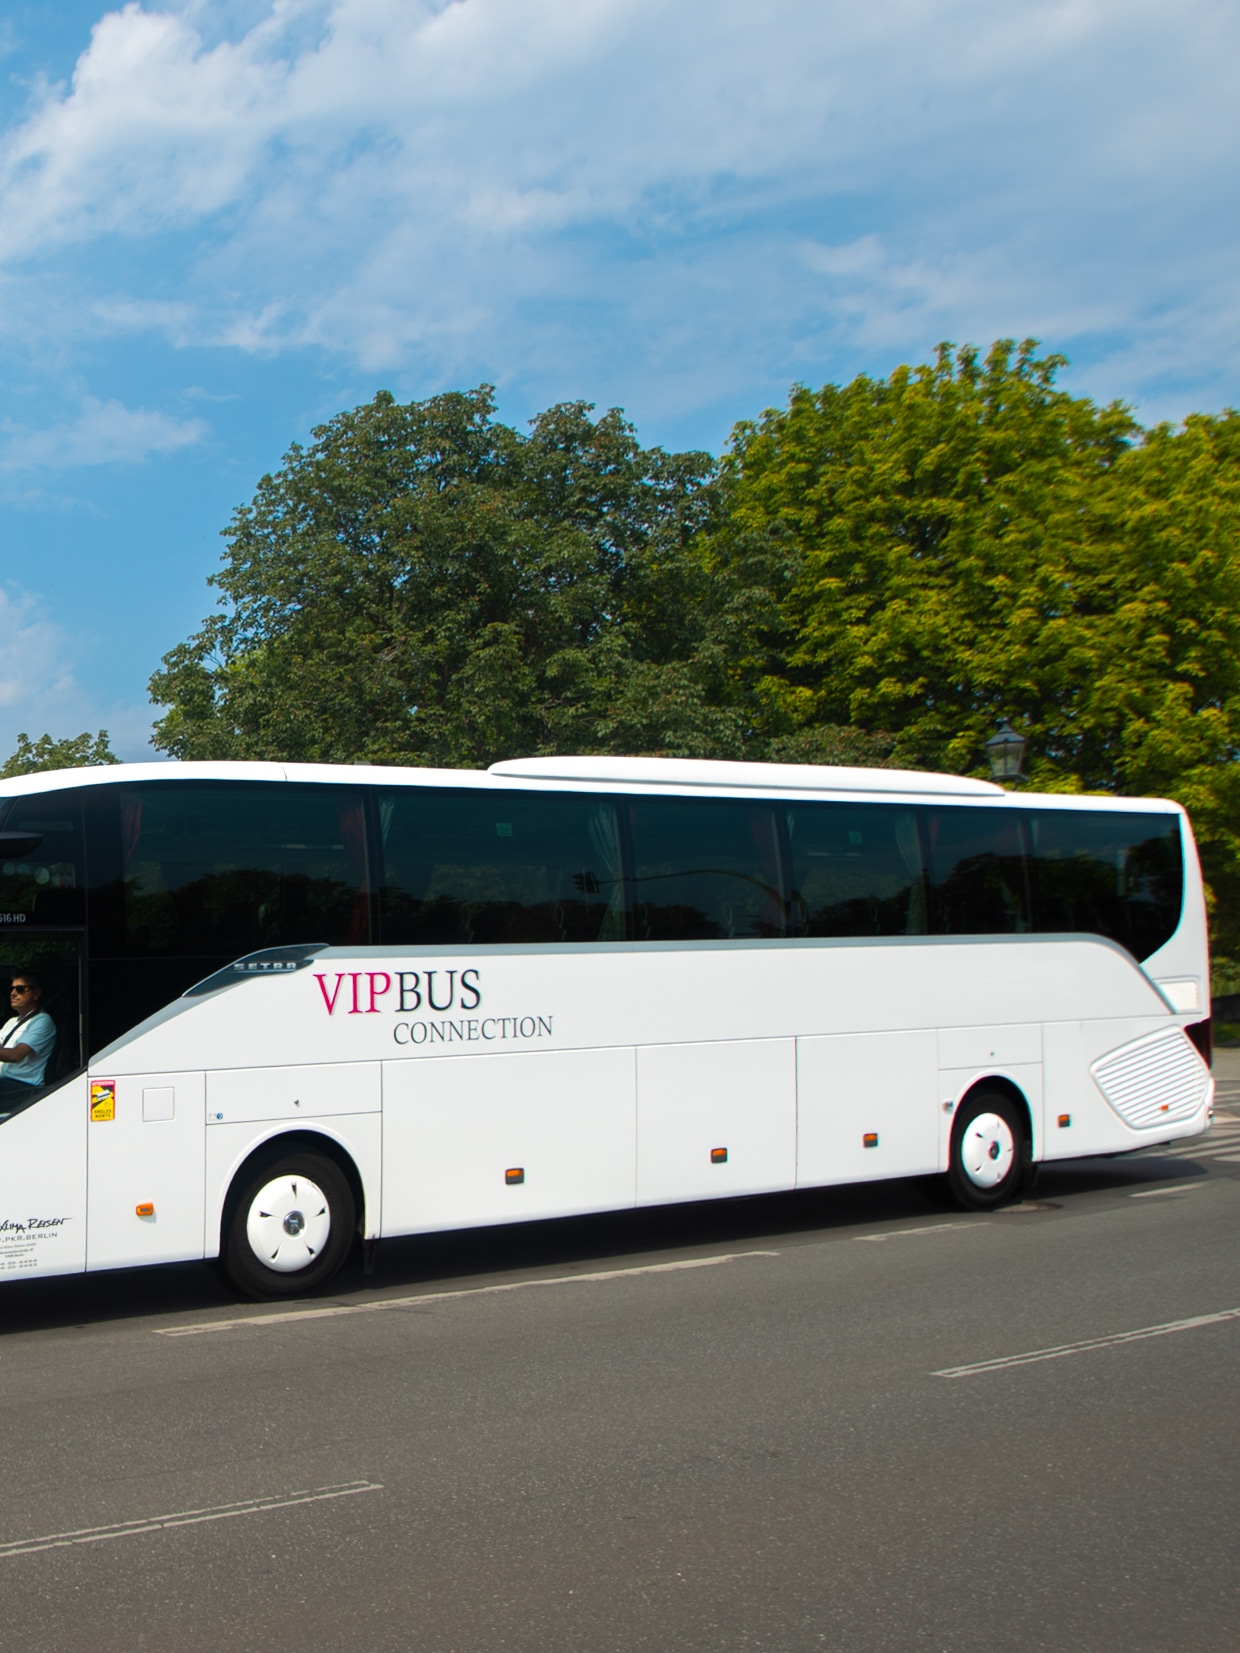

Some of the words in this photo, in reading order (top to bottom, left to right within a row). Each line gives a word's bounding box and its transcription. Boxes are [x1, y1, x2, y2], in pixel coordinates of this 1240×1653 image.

[12, 913, 26, 923] HD
[234, 962, 297, 970] SETRA
[313, 969, 481, 1016] VIPBUS
[393, 1015, 553, 1045] CONNECTION
